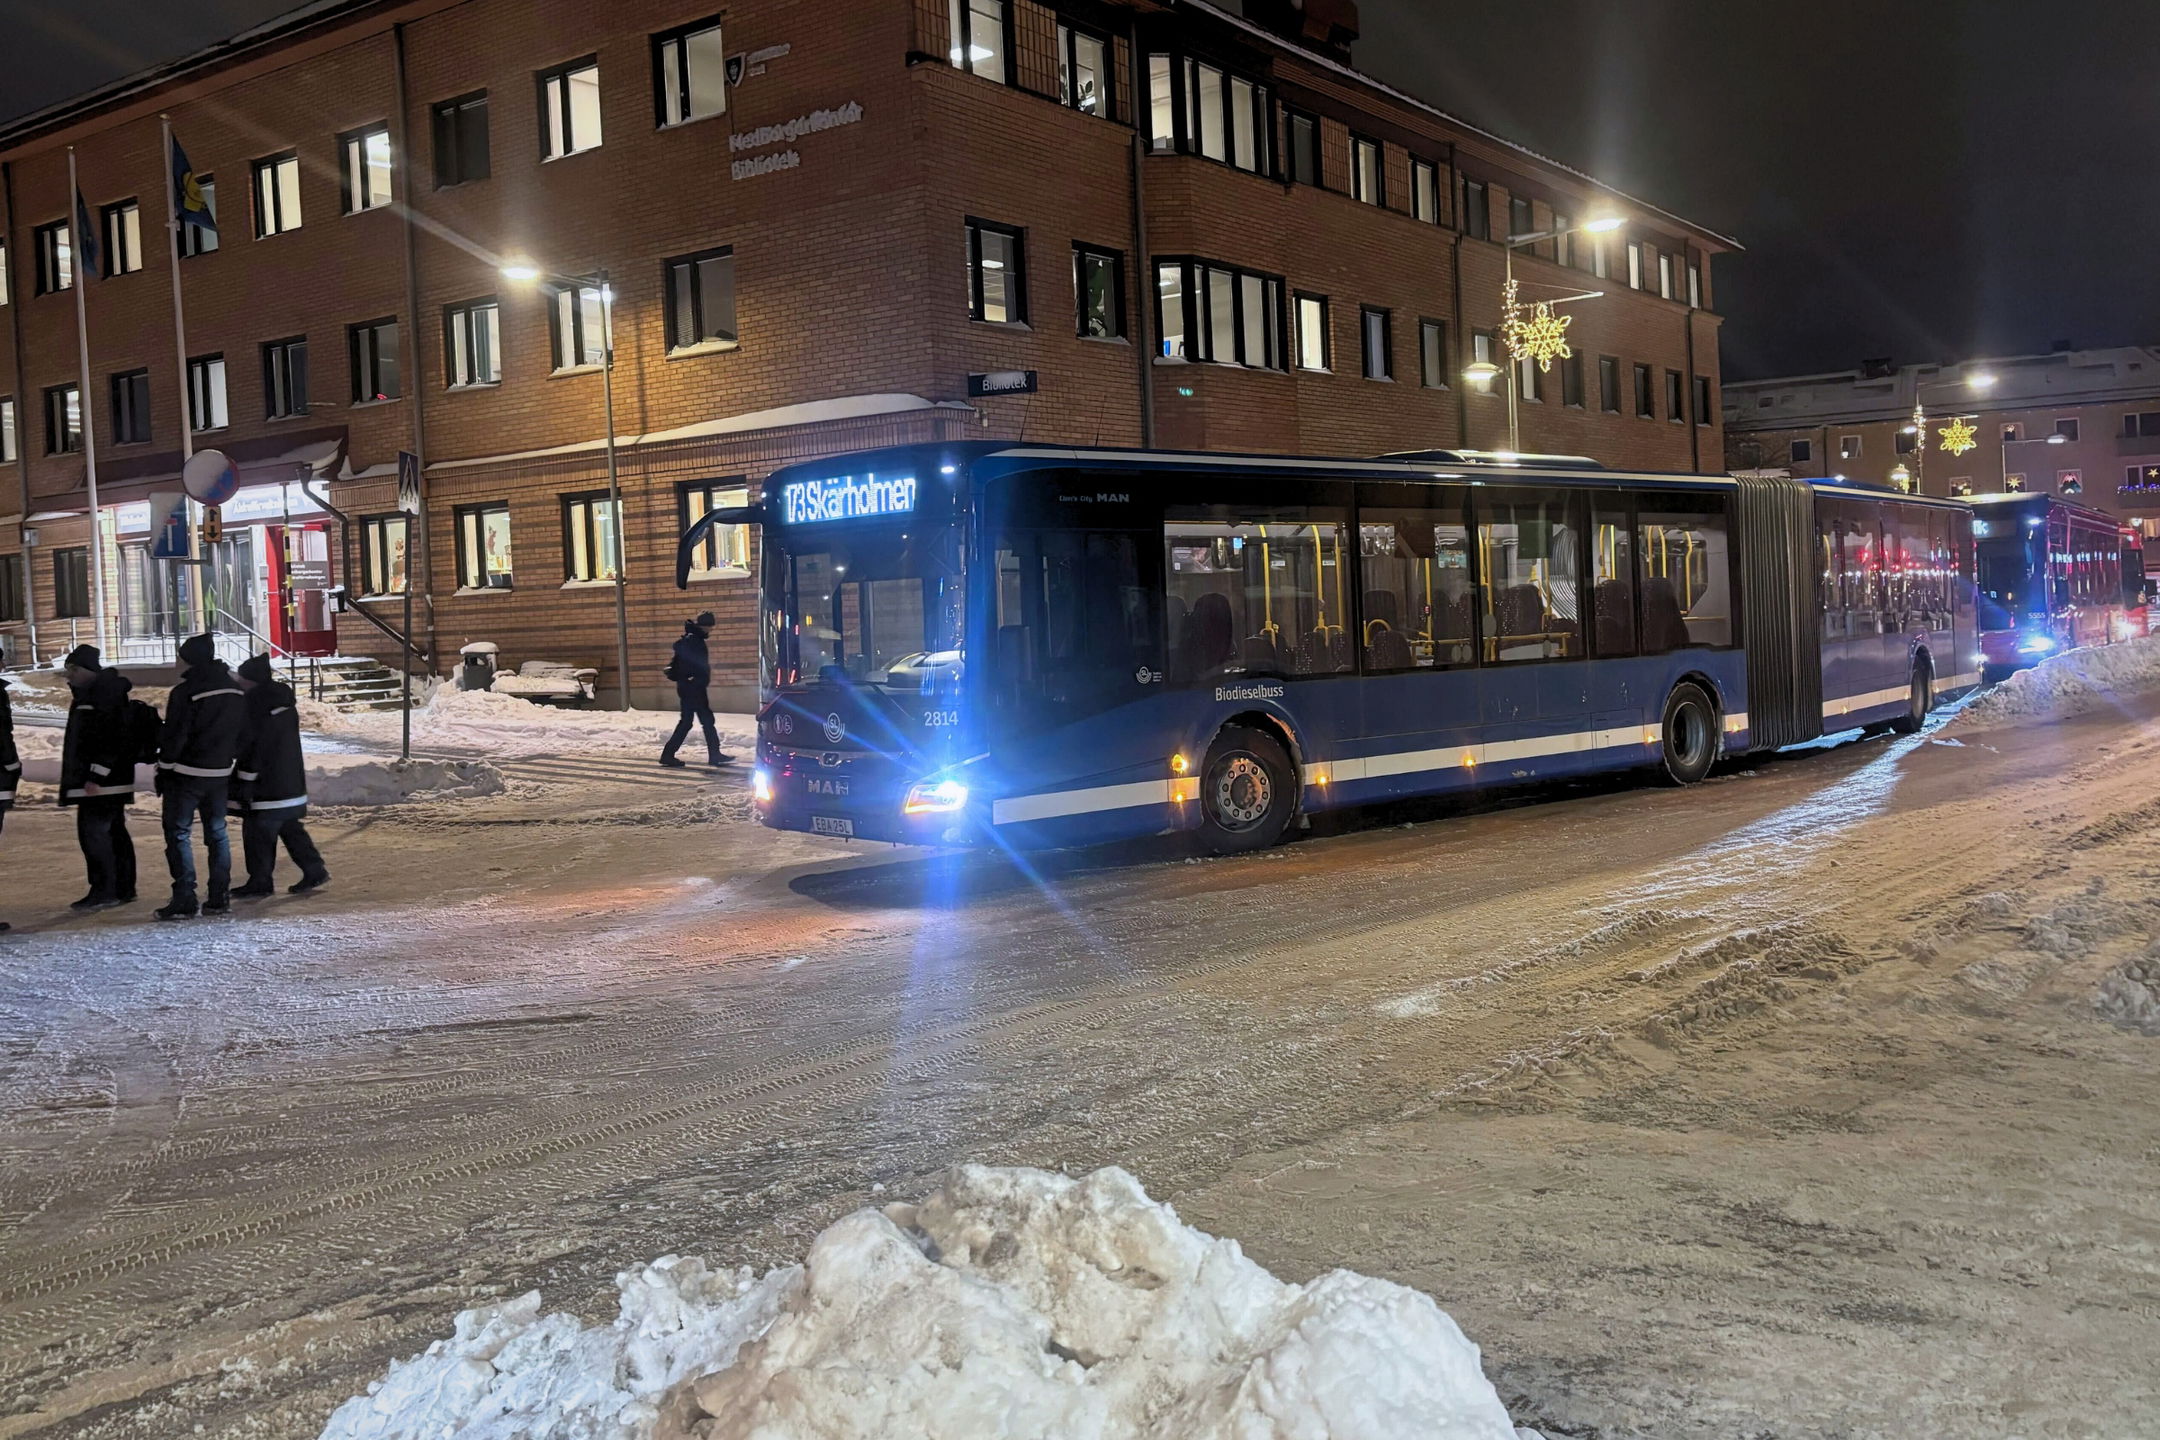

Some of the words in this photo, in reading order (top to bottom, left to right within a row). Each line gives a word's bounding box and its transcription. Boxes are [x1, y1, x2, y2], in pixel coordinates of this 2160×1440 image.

[785, 483, 805, 523] 173
[806, 473, 916, 520] Skärholmen
[1096, 493, 1130, 503] MAN
[1215, 685, 1284, 701] Biodieselbuss
[924, 711, 959, 727] 2814
